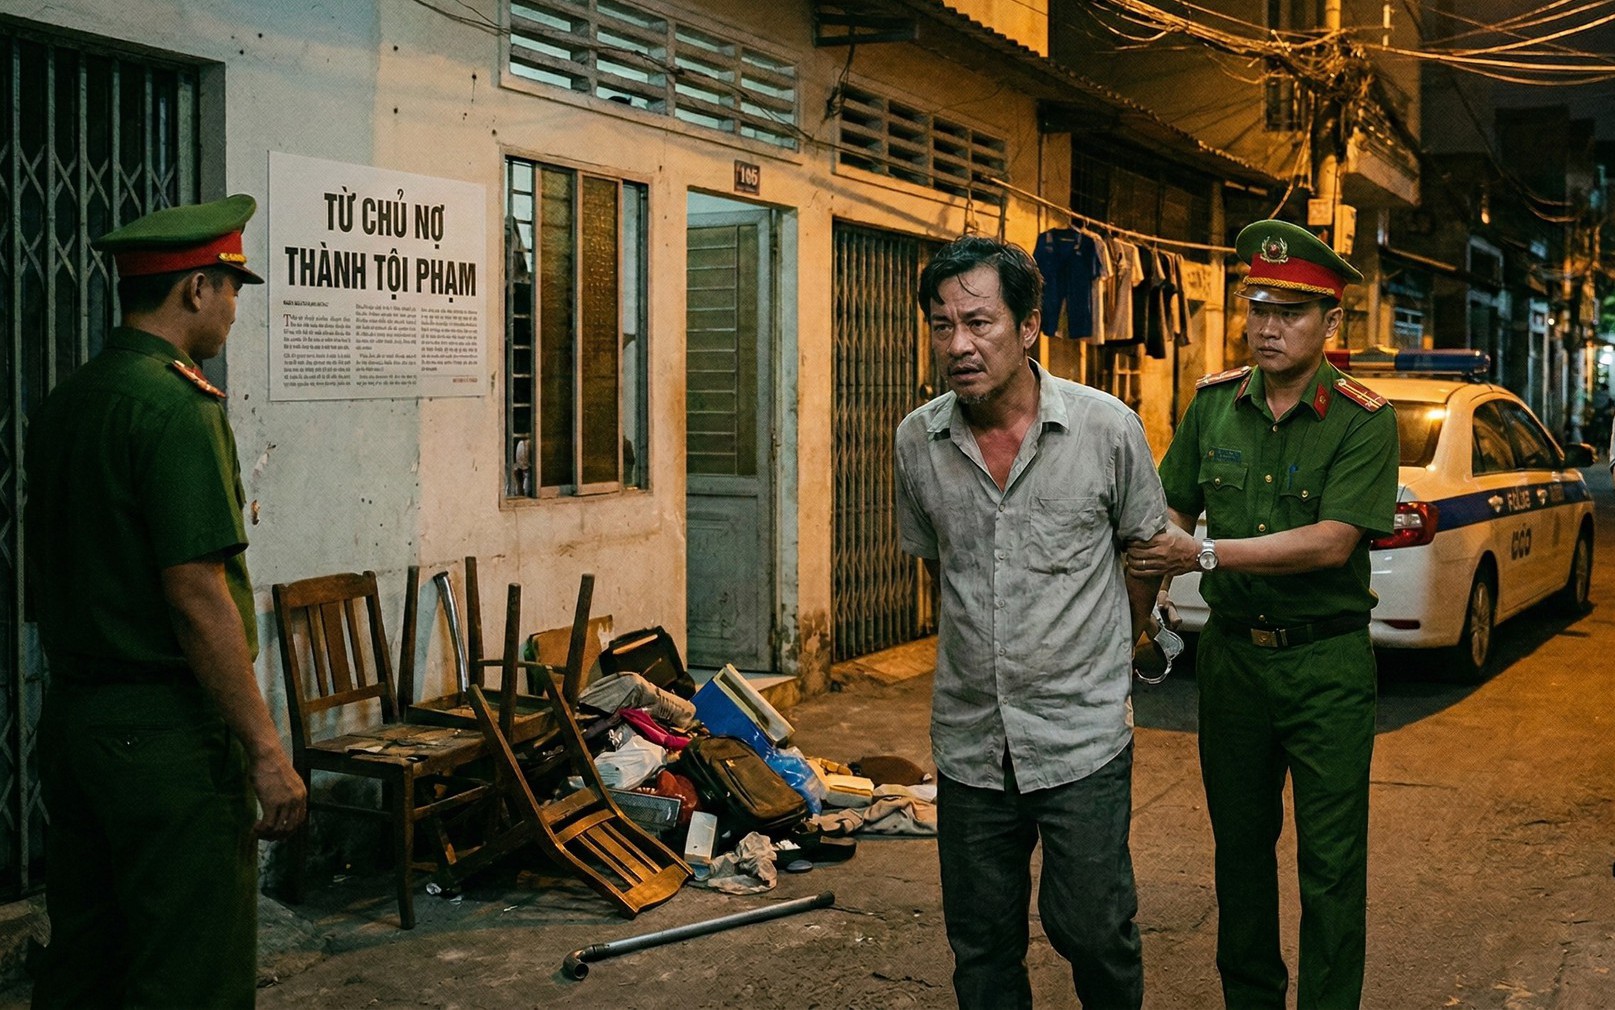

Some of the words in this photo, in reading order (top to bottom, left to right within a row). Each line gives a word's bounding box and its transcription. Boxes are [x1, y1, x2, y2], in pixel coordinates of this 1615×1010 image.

[324, 186, 356, 233] TỪ
[362, 188, 407, 238] CHỦ
[415, 204, 445, 249] NỢ
[285, 242, 367, 291] THÀNH
[374, 248, 409, 300] TỘI
[416, 258, 477, 303] PHẠM
